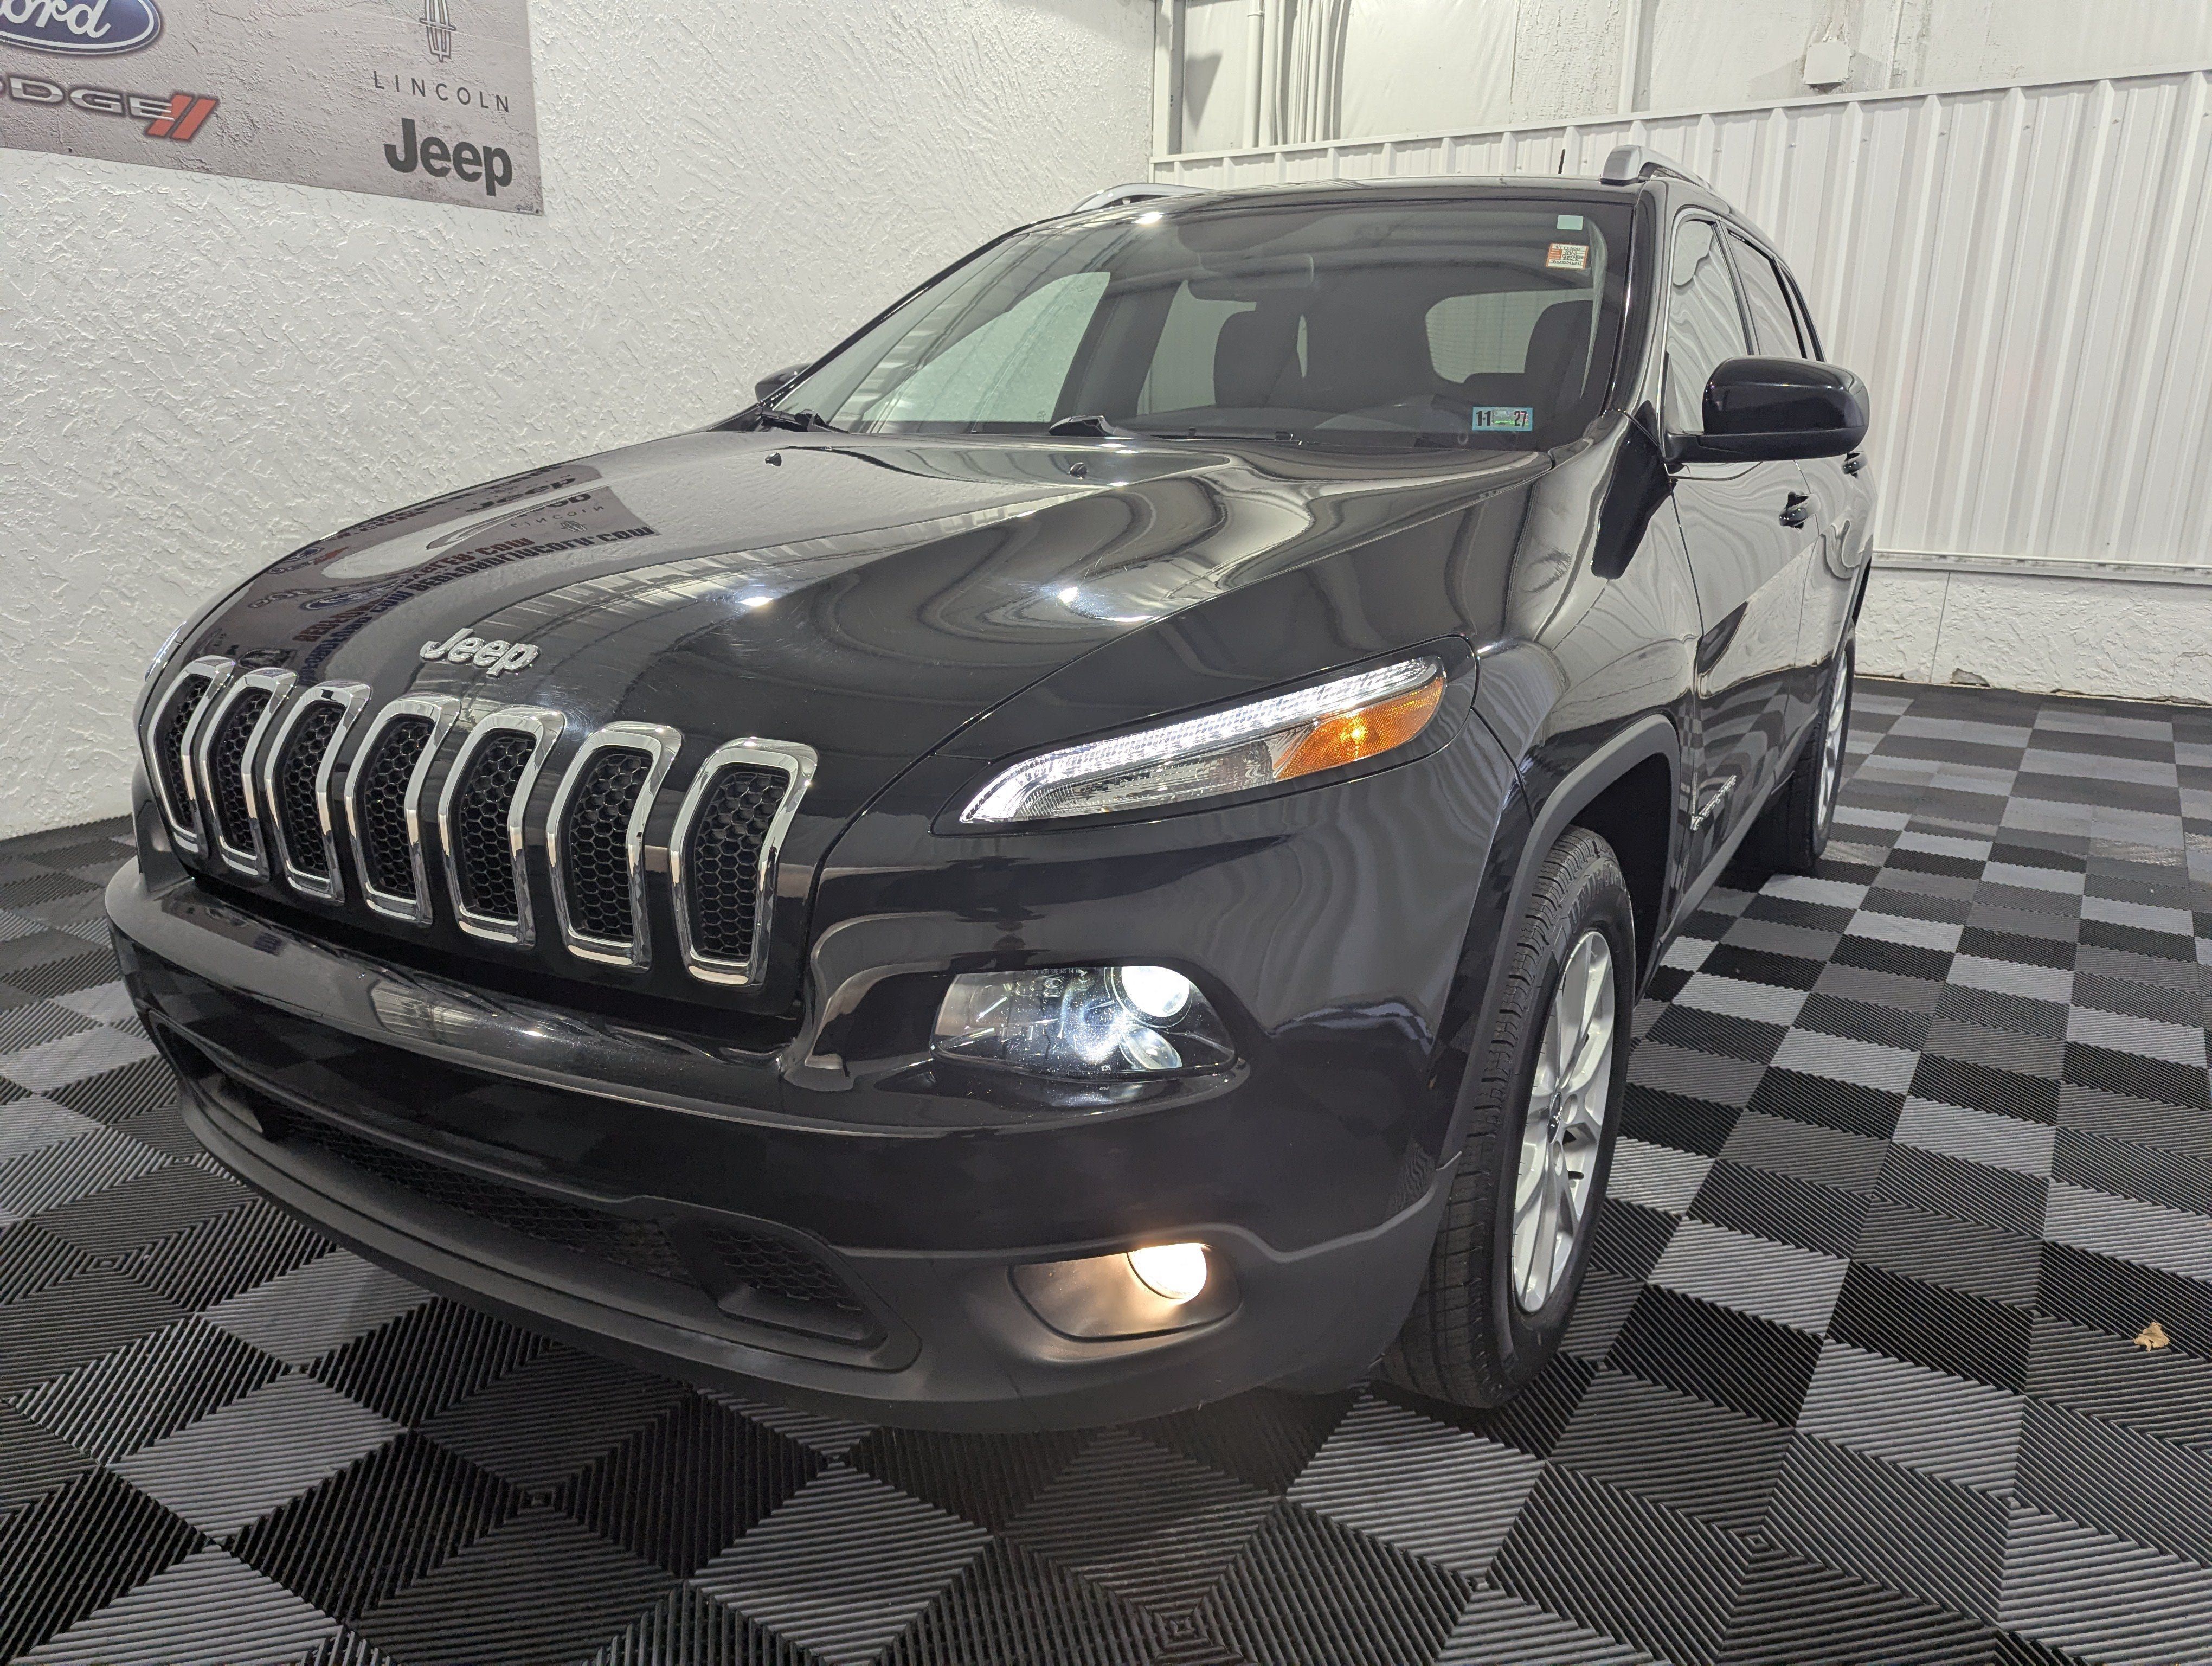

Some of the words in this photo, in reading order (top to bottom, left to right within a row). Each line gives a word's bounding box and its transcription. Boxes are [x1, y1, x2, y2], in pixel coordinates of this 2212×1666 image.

[0, 0, 111, 39] ord
[9, 77, 175, 122] DGE
[372, 70, 509, 113] LINCOLN
[383, 118, 513, 196] Jeep
[1476, 410, 1491, 427] 11
[1514, 410, 1527, 427] 27
[419, 627, 542, 677] Jeep
